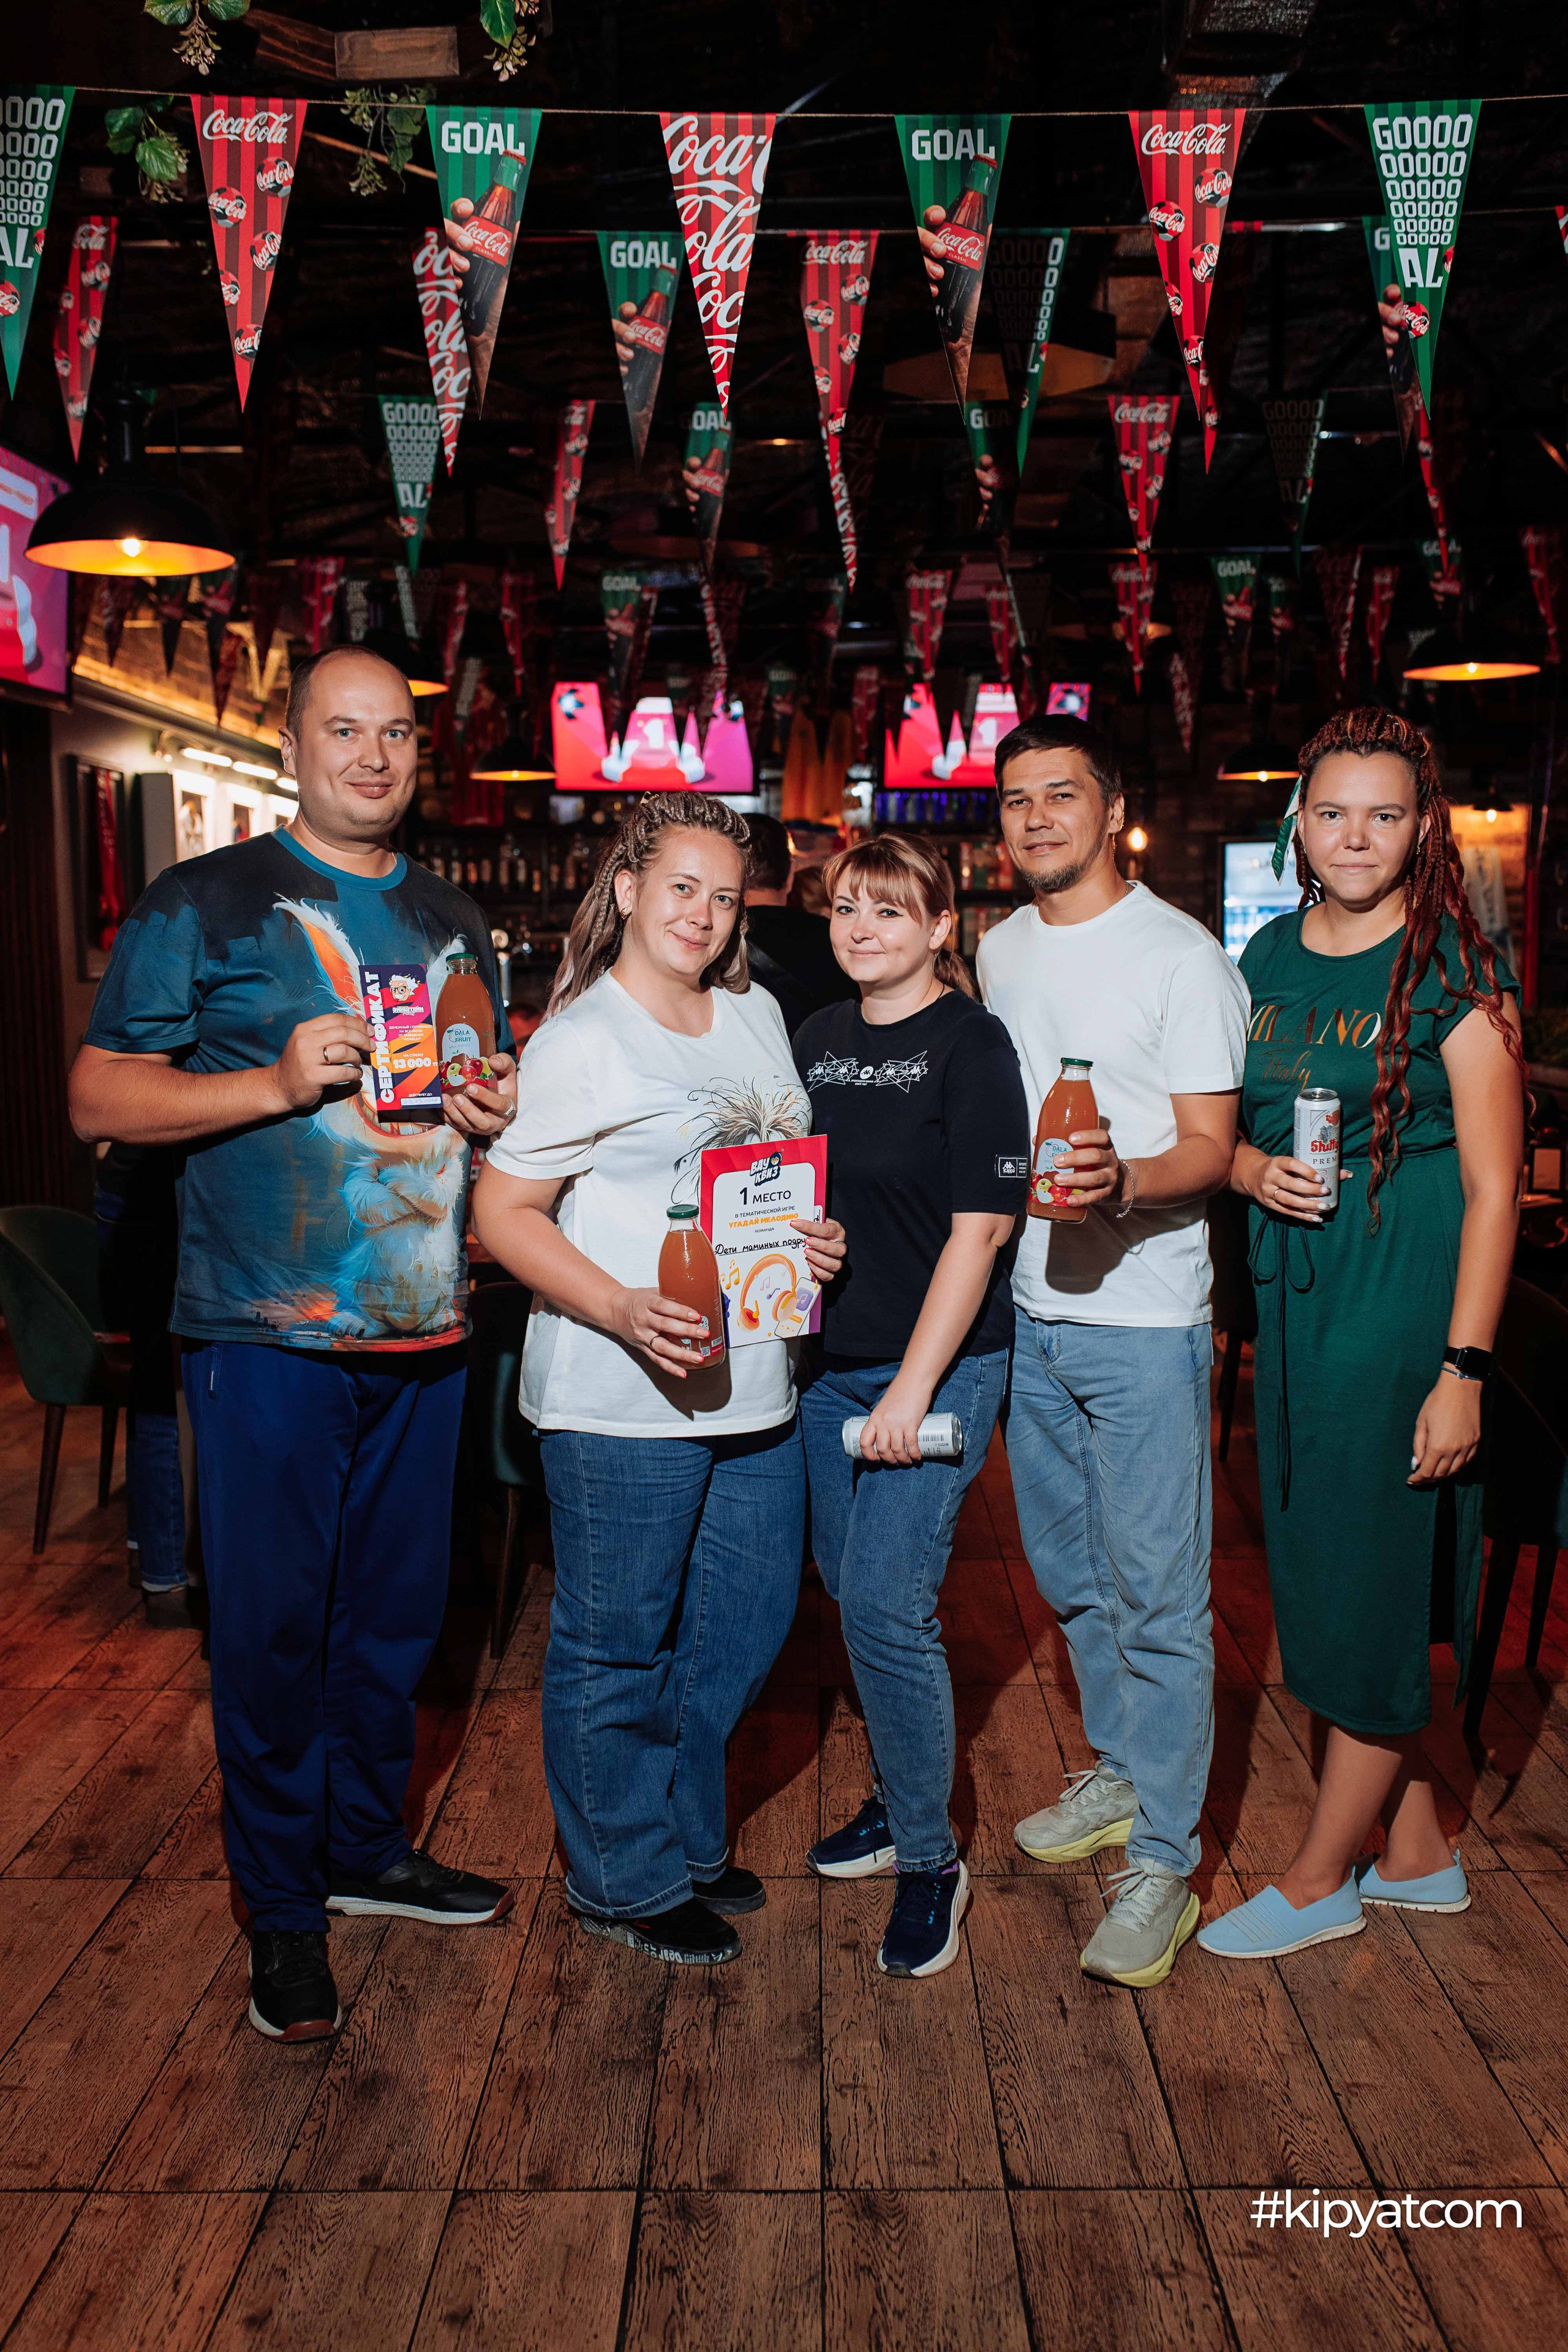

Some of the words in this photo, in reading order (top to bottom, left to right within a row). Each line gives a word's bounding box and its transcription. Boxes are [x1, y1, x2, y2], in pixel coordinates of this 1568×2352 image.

[203, 109, 293, 144] Coca-Cola
[442, 121, 525, 156] GOAL
[1141, 123, 1232, 155] Coca-Cola
[912, 129, 995, 160] GOAL
[464, 221, 512, 257] Coca-Cola
[802, 239, 869, 265] Coca-Cola
[937, 227, 984, 261] Coca-Cola
[611, 241, 677, 268] GOAL
[1398, 247, 1443, 288] AL
[364, 971, 395, 1103] СЕРТИФИКАТ
[393, 1058, 406, 1069] 13
[407, 1057, 432, 1068] 000
[1258, 1048, 1313, 1095] Italy
[750, 1156, 771, 1175] ВАУ
[755, 1166, 780, 1186] КВИЗ
[739, 1187, 748, 1205] 1
[753, 1190, 791, 1204] МЕСТО
[728, 1217, 760, 1229] УГАДАЙ
[760, 1213, 799, 1224] МЕЛОДИЮ
[740, 1207, 781, 1218] ТЕМАТИЧЕСКОЙ
[714, 1243, 737, 1256] Дети
[742, 1242, 779, 1253] маминых
[782, 1237, 807, 1250] подру
